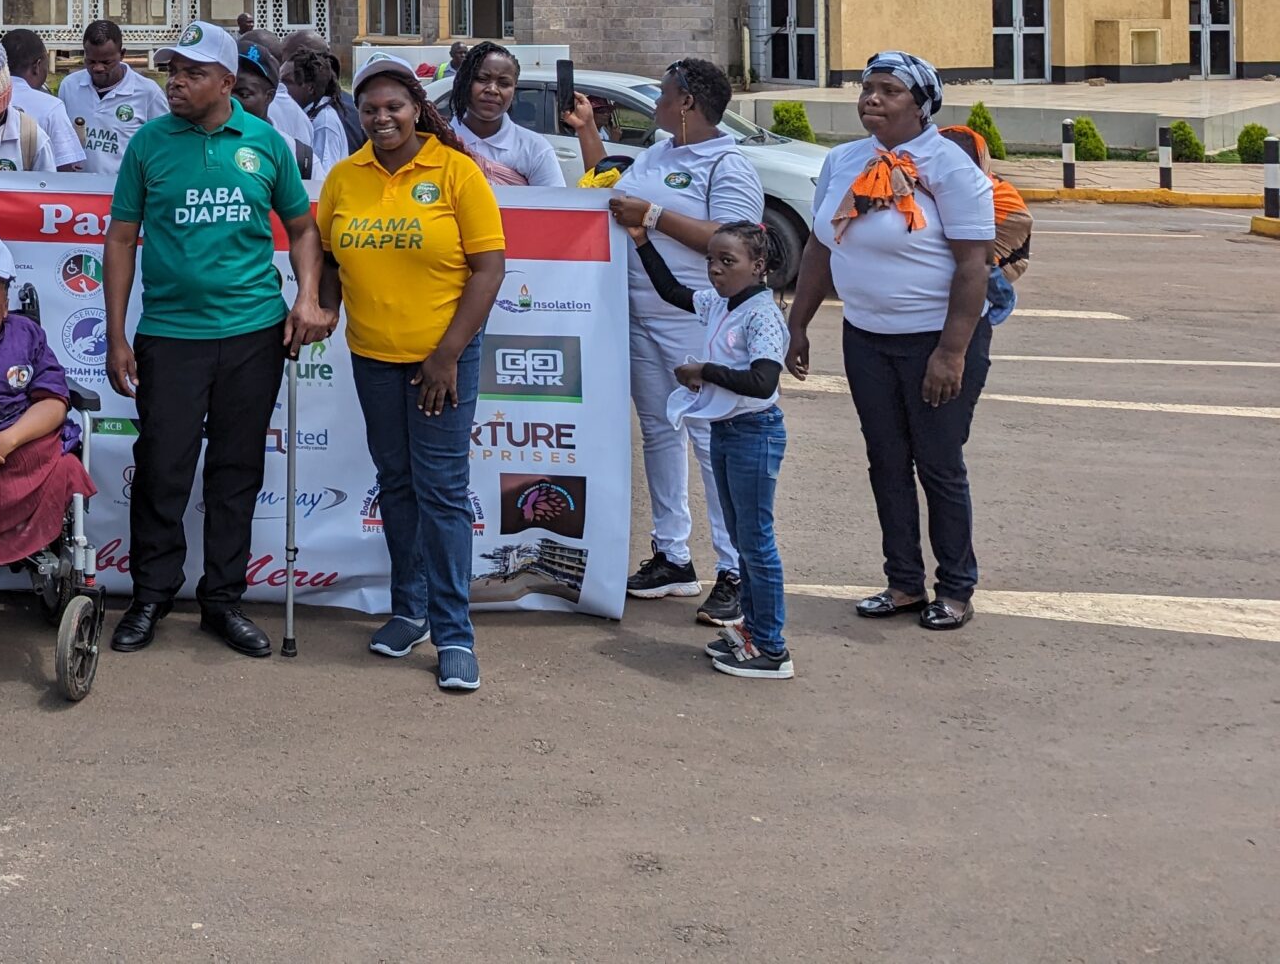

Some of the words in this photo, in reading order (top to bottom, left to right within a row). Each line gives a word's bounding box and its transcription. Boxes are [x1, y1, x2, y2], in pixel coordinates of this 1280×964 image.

[85, 139, 119, 154] APER
[185, 186, 245, 206] BABA
[174, 205, 252, 224] DIAPER
[347, 217, 423, 232] MAMA
[339, 232, 425, 250] DIAPER
[63, 320, 76, 350] SOCIAL
[496, 374, 565, 386] BANK
[104, 422, 123, 431] KCB
[470, 421, 577, 451] RTURE
[359, 496, 373, 517] Boda
[471, 495, 484, 520] Kenya
